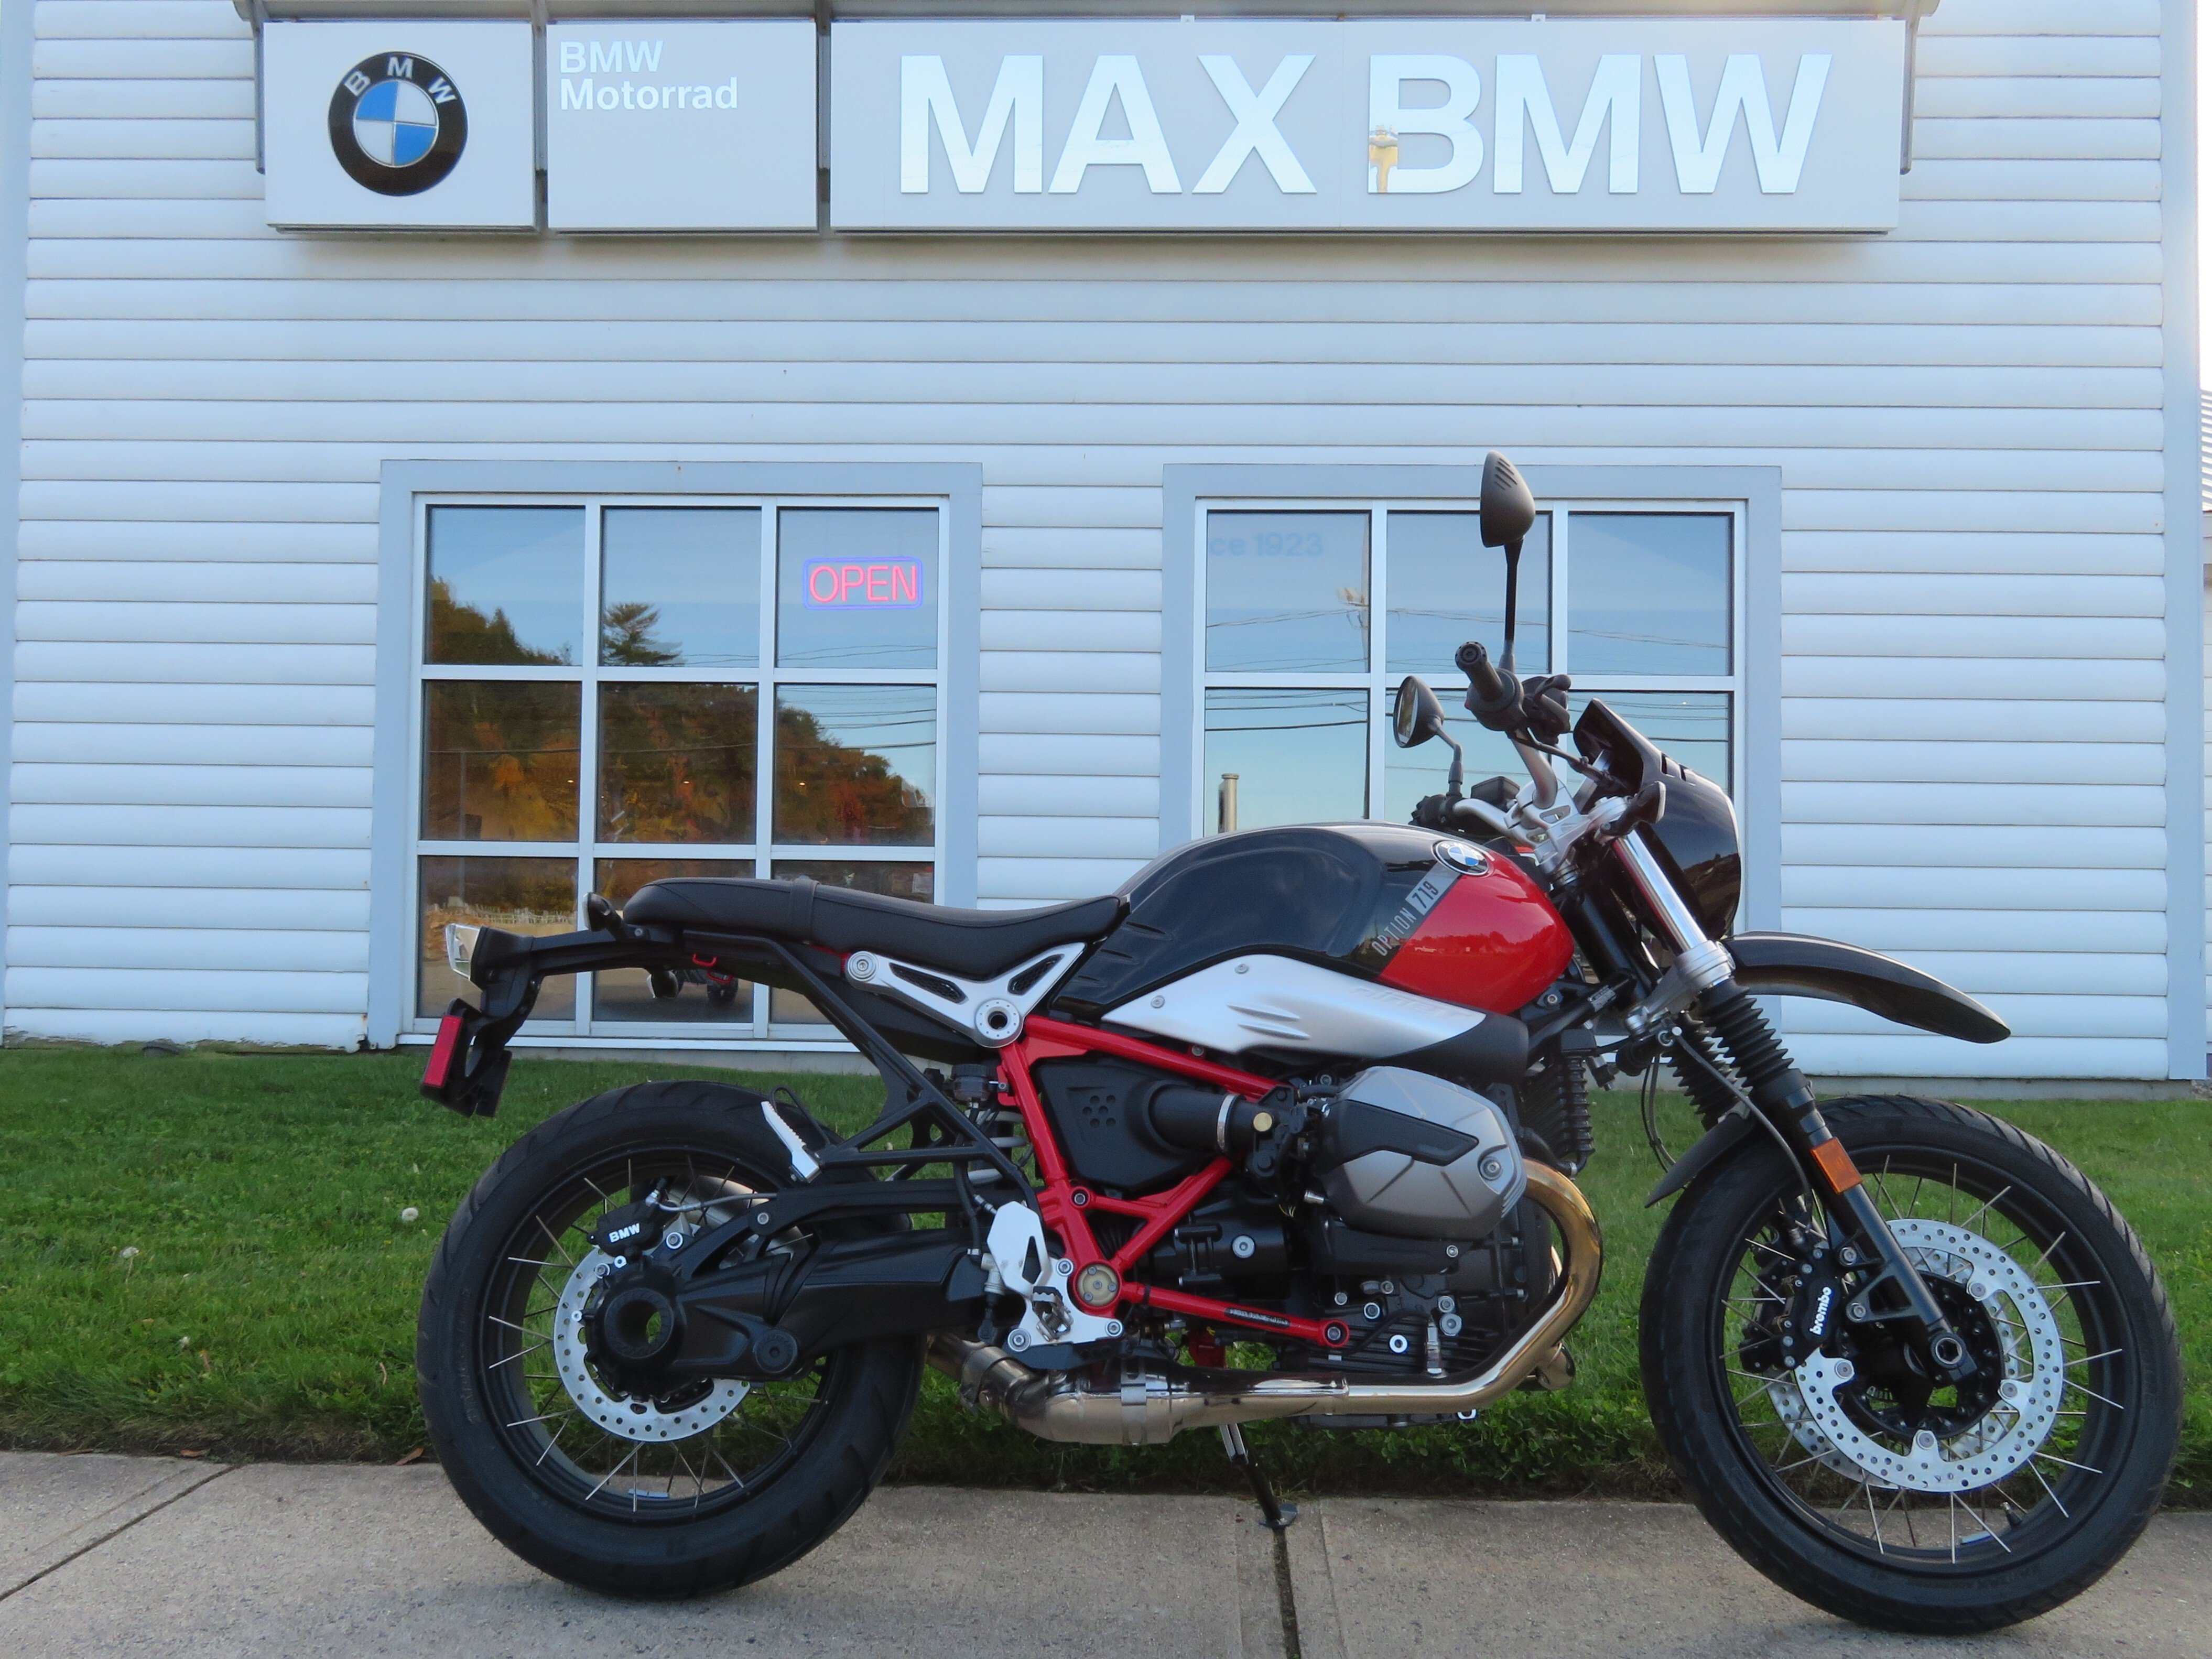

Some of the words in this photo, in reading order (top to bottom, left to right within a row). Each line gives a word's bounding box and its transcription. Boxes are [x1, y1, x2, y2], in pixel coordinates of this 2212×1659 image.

[560, 40, 664, 73] BMW
[343, 56, 457, 104] BMW
[560, 76, 738, 111] Motorrad
[899, 55, 1317, 194] MAX
[1368, 55, 1833, 194] BMW
[1254, 532, 1324, 557] 1923
[809, 565, 917, 603] OPEN
[1371, 907, 1417, 957] OPTION
[1412, 880, 1439, 909] 719
[609, 1223, 640, 1242] BMW
[1809, 1286, 1832, 1335] brembo
